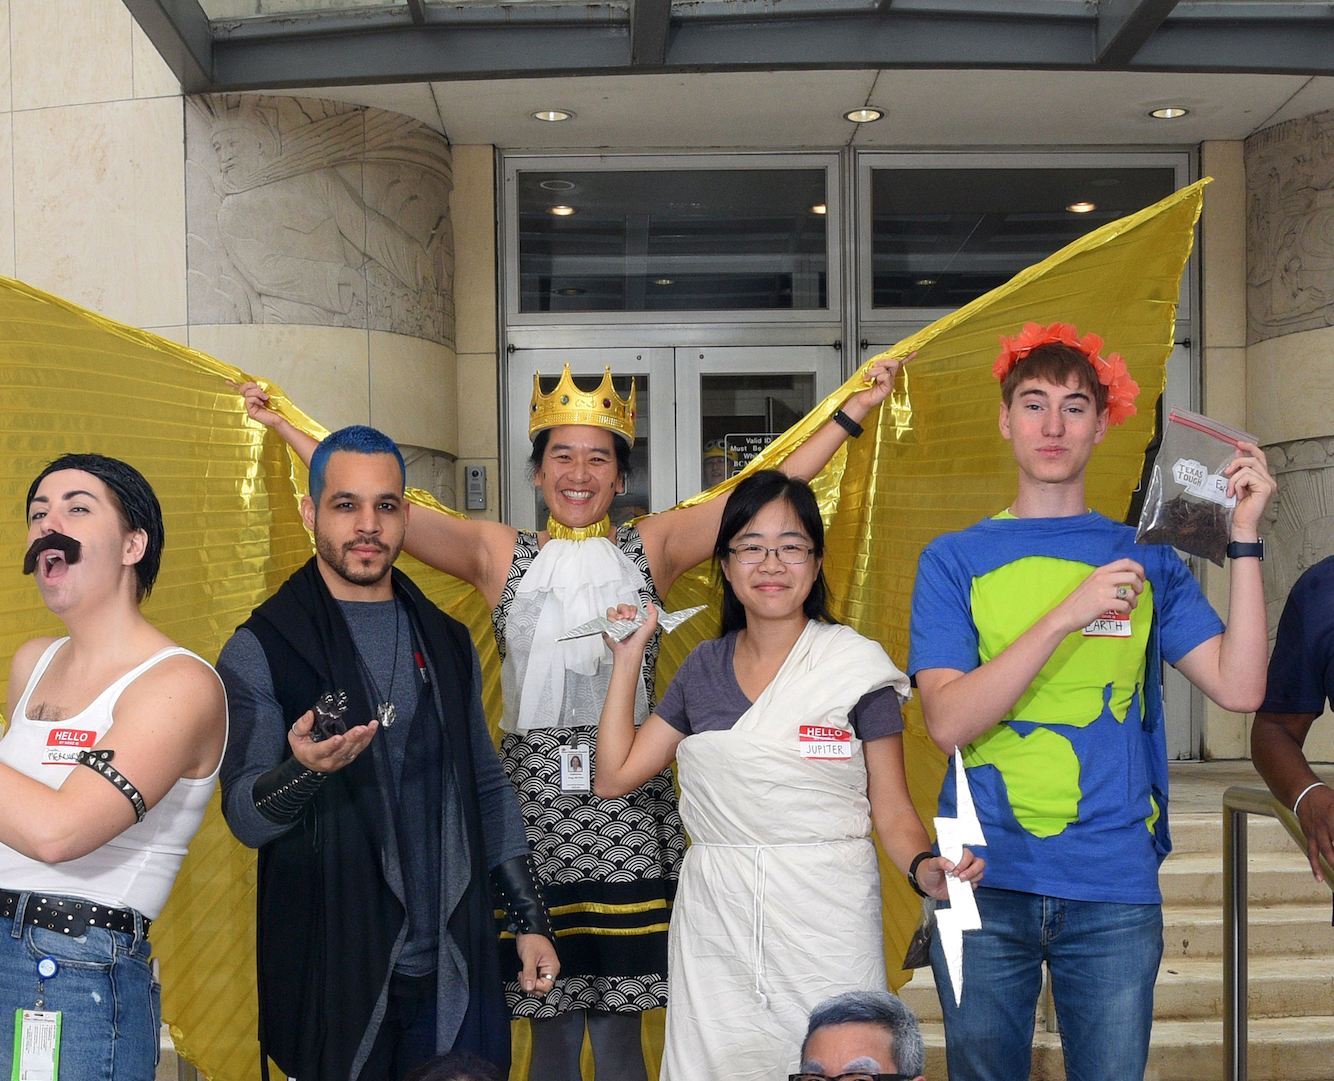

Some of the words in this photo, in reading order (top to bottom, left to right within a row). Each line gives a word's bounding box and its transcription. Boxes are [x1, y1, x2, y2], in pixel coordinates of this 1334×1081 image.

[1179, 464, 1204, 479] TEXAS
[1177, 471, 1203, 487] TOUGH
[55, 731, 88, 742] HELLO
[807, 727, 843, 737] HELLO
[806, 744, 845, 755] JUPITER
